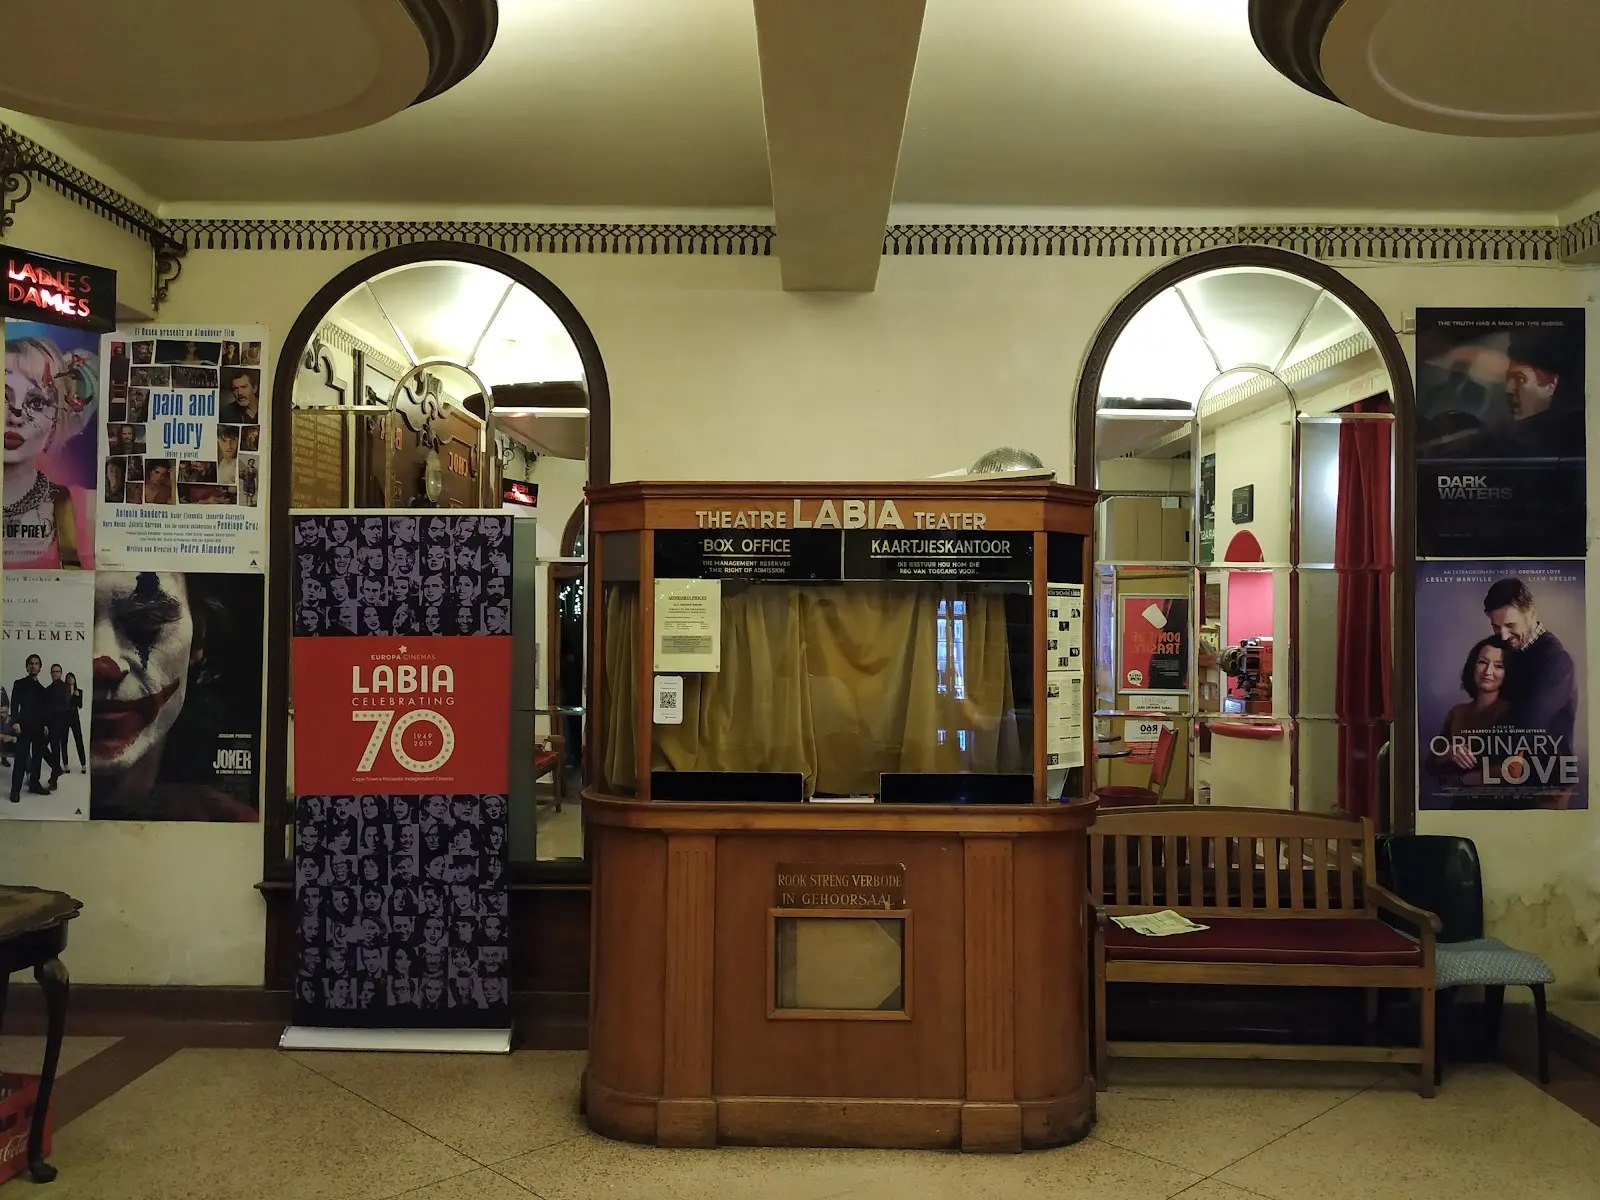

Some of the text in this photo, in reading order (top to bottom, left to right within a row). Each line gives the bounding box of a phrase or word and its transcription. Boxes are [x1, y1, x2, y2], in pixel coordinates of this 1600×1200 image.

[8, 259, 92, 294] LADIES
[8, 282, 91, 317] DAMES
[152, 389, 216, 421] pain and
[163, 417, 203, 450] glory
[1437, 475, 1488, 488] DARK
[1438, 487, 1513, 500] WATERS
[695, 498, 987, 531] THEATRE LABIA TEATER
[7, 524, 47, 539] OF PREY
[180, 543, 199, 553] Pedro
[703, 538, 791, 553] BOX OFFICE
[871, 539, 1011, 554] KAARTJIESKANTOOR
[402, 653, 436, 661] CINEMAS
[352, 664, 454, 694] LABIA
[351, 696, 455, 707] CELEBRATING
[352, 708, 455, 773] 70
[413, 732, 433, 740] 1949
[1429, 735, 1564, 757] ORDINARY
[212, 748, 252, 770] JOKER
[1482, 755, 1580, 785] LOVE
[777, 874, 807, 887] ROOK
[810, 874, 849, 887] STRENG
[782, 892, 895, 906] IN GEHOORSAAL
